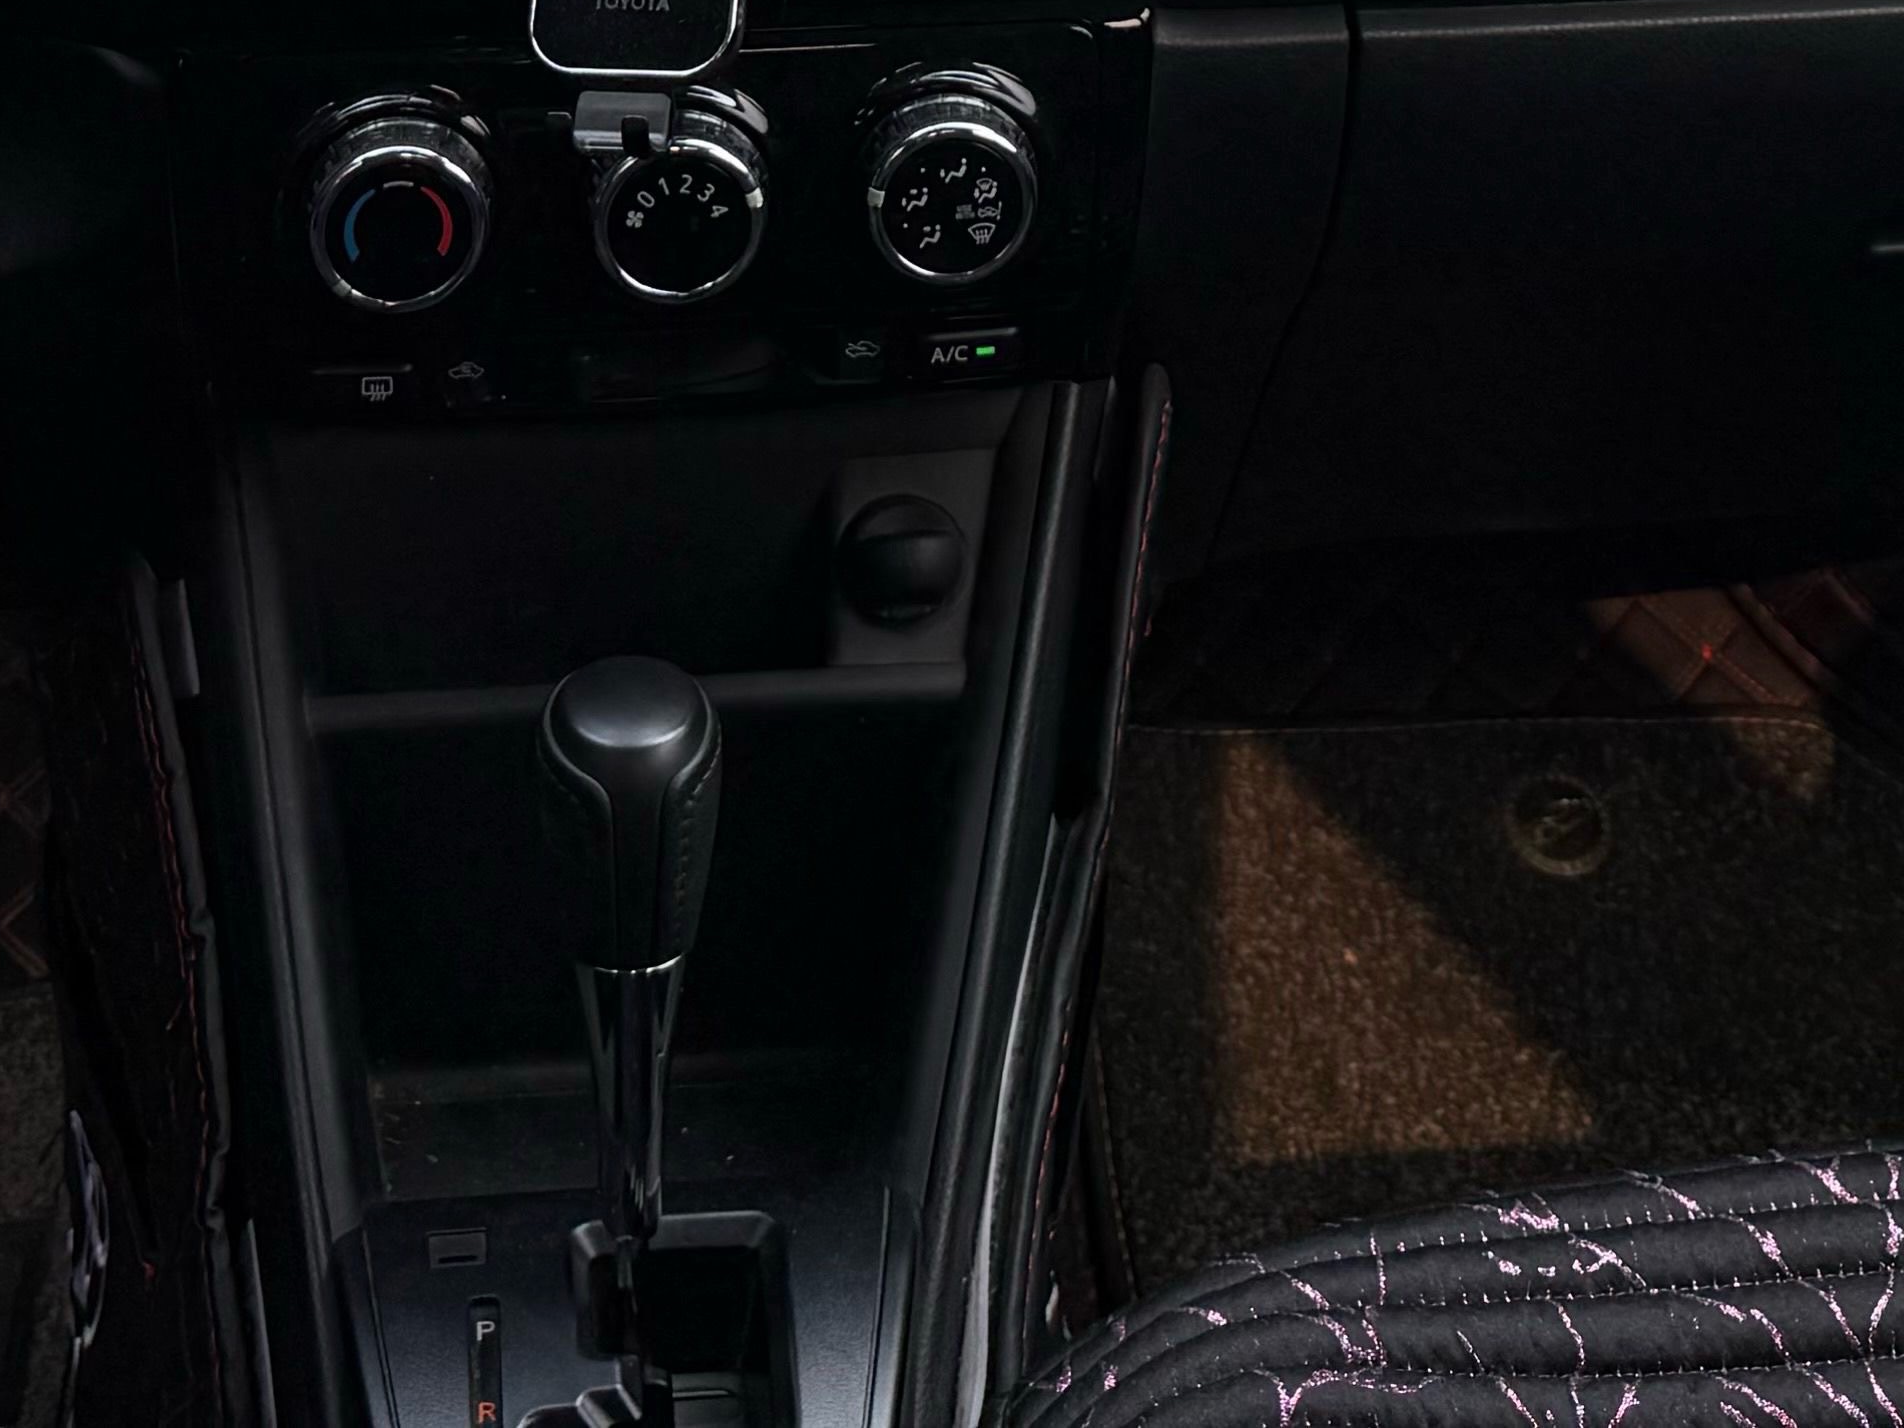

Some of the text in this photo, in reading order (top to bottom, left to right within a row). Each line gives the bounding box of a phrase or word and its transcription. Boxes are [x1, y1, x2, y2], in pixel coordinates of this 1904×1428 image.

[657, 176, 672, 197] 1
[678, 173, 695, 196] 2
[696, 182, 717, 204] 3
[636, 190, 657, 209] 0
[709, 203, 730, 219] 4
[928, 342, 972, 366] A/C
[474, 1319, 497, 1343] P
[475, 1401, 497, 1424] R
